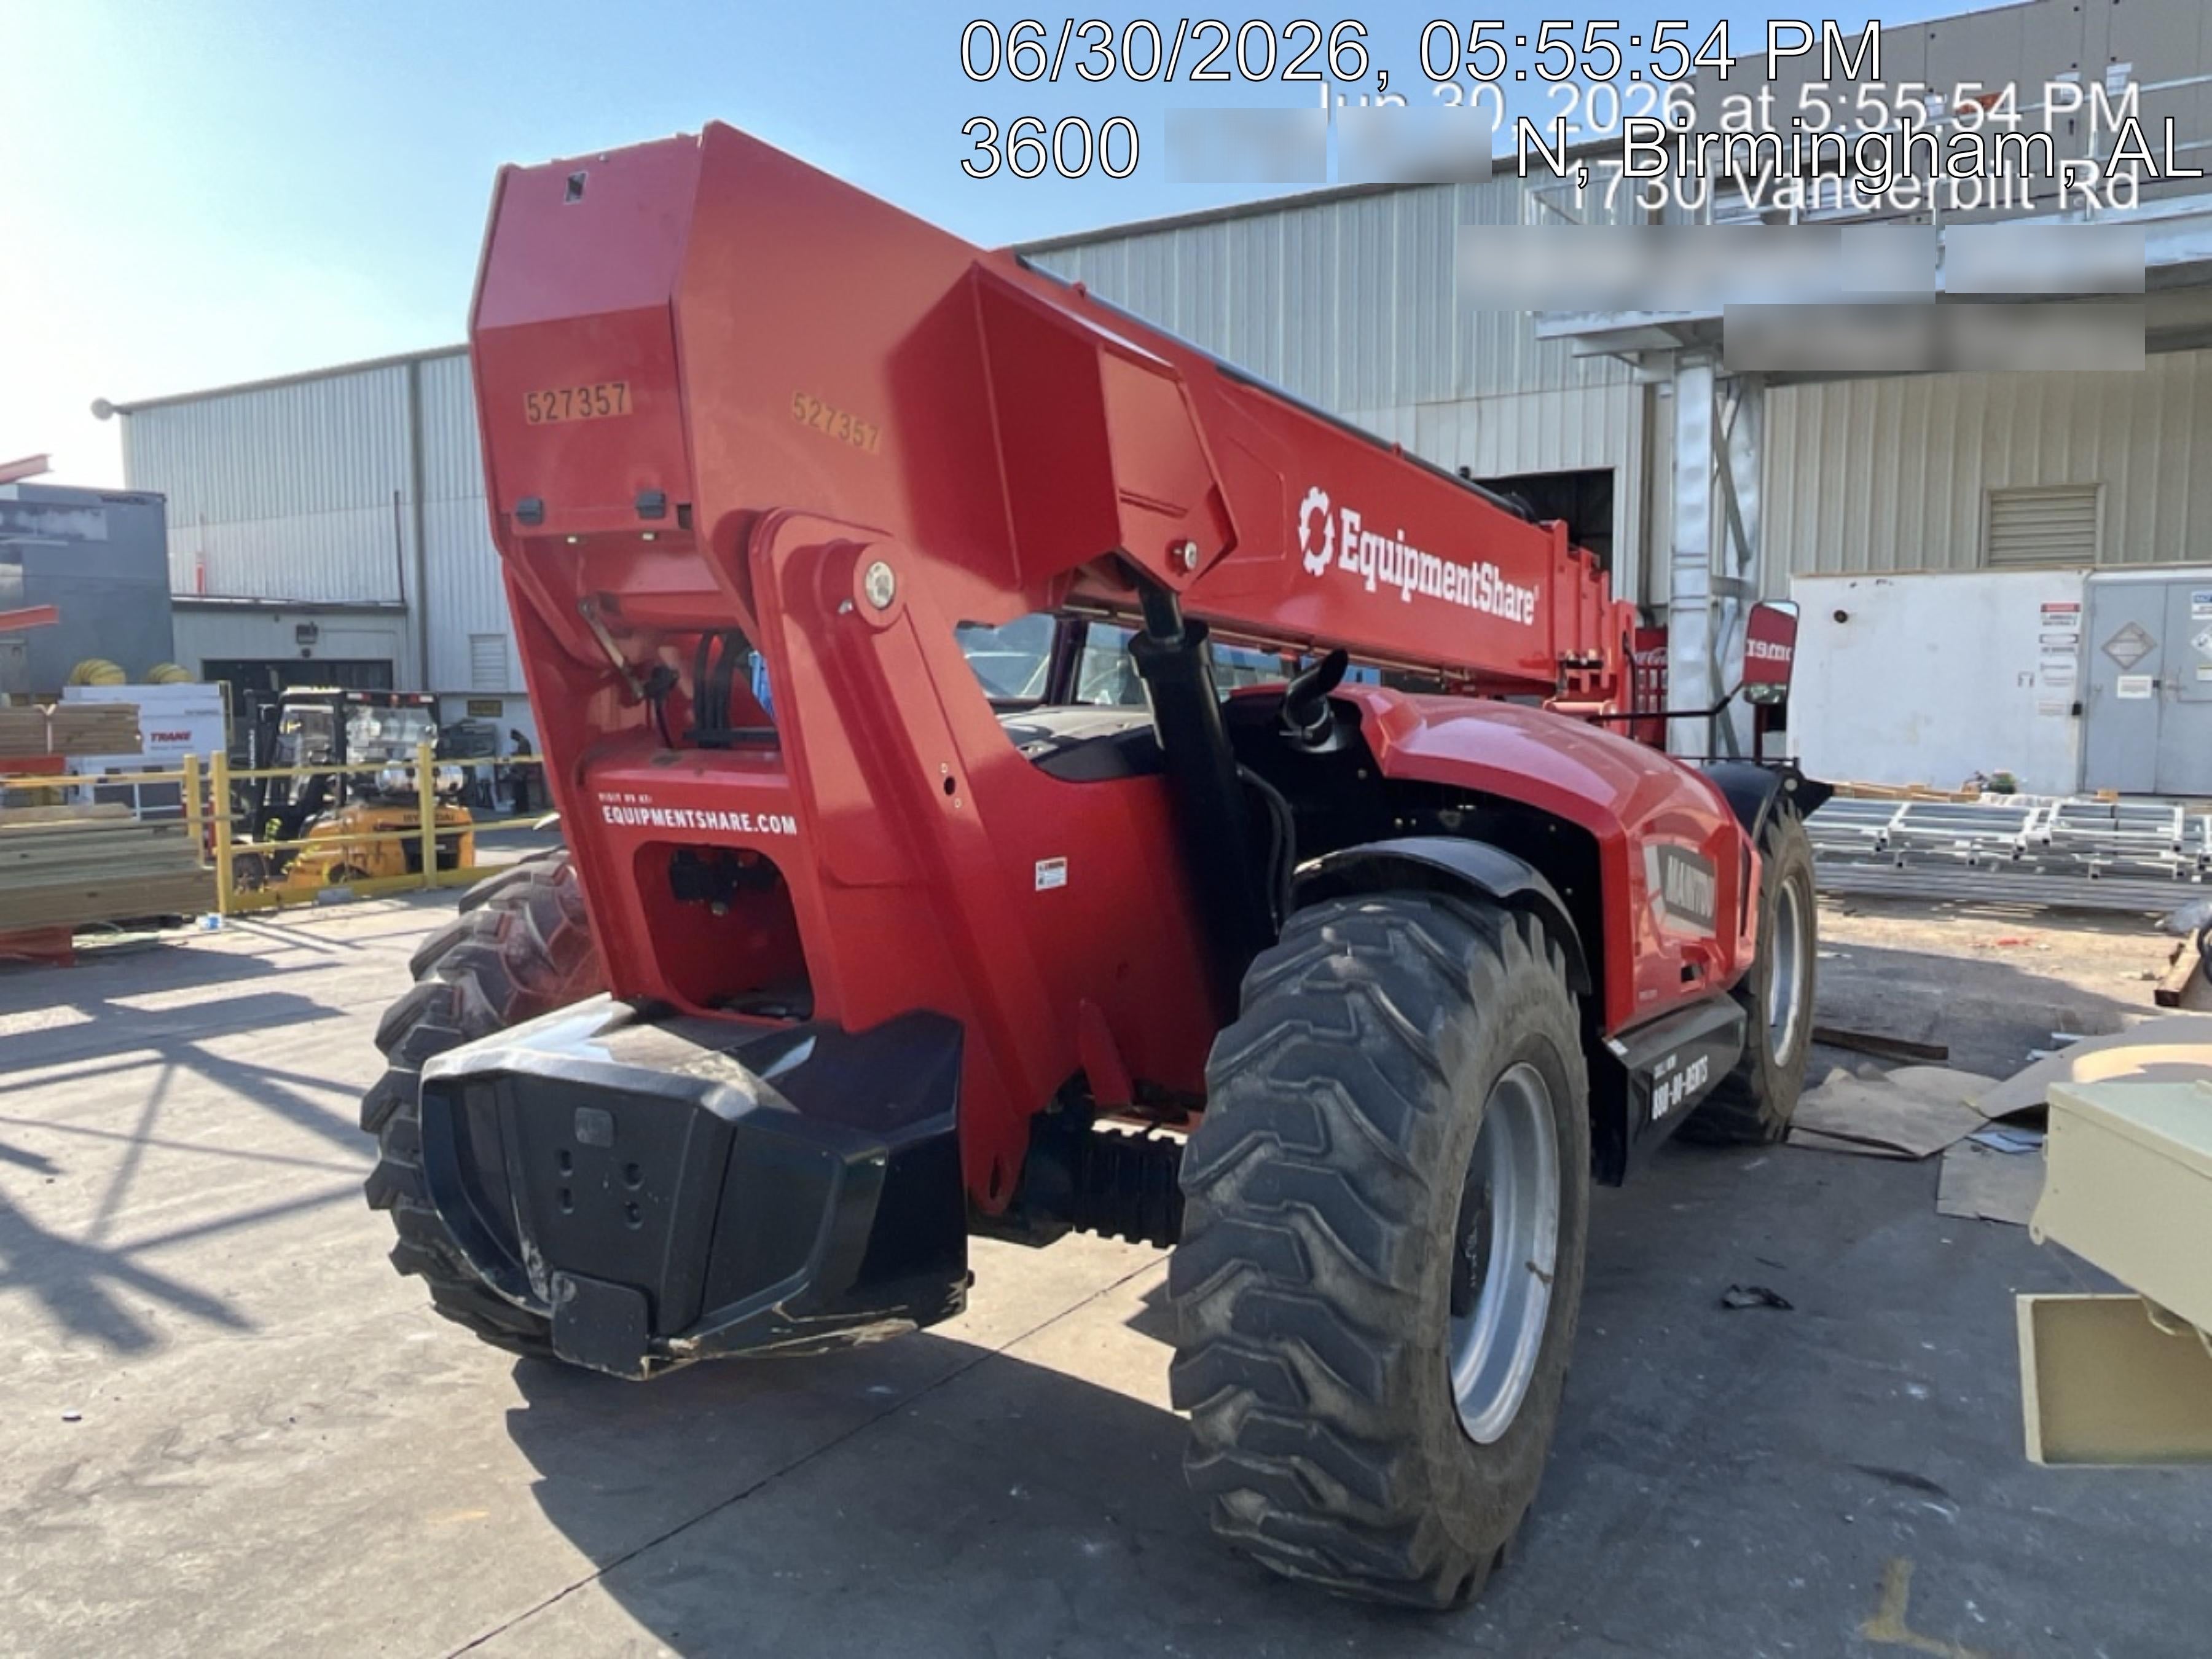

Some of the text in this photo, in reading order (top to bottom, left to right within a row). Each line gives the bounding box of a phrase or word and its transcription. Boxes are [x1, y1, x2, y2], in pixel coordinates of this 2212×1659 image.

[525, 382, 627, 423] 527357
[792, 391, 880, 452] 527357
[1338, 507, 1535, 626] EquipmentShare
[602, 805, 798, 836] EQUIPMENTSHARE.COM
